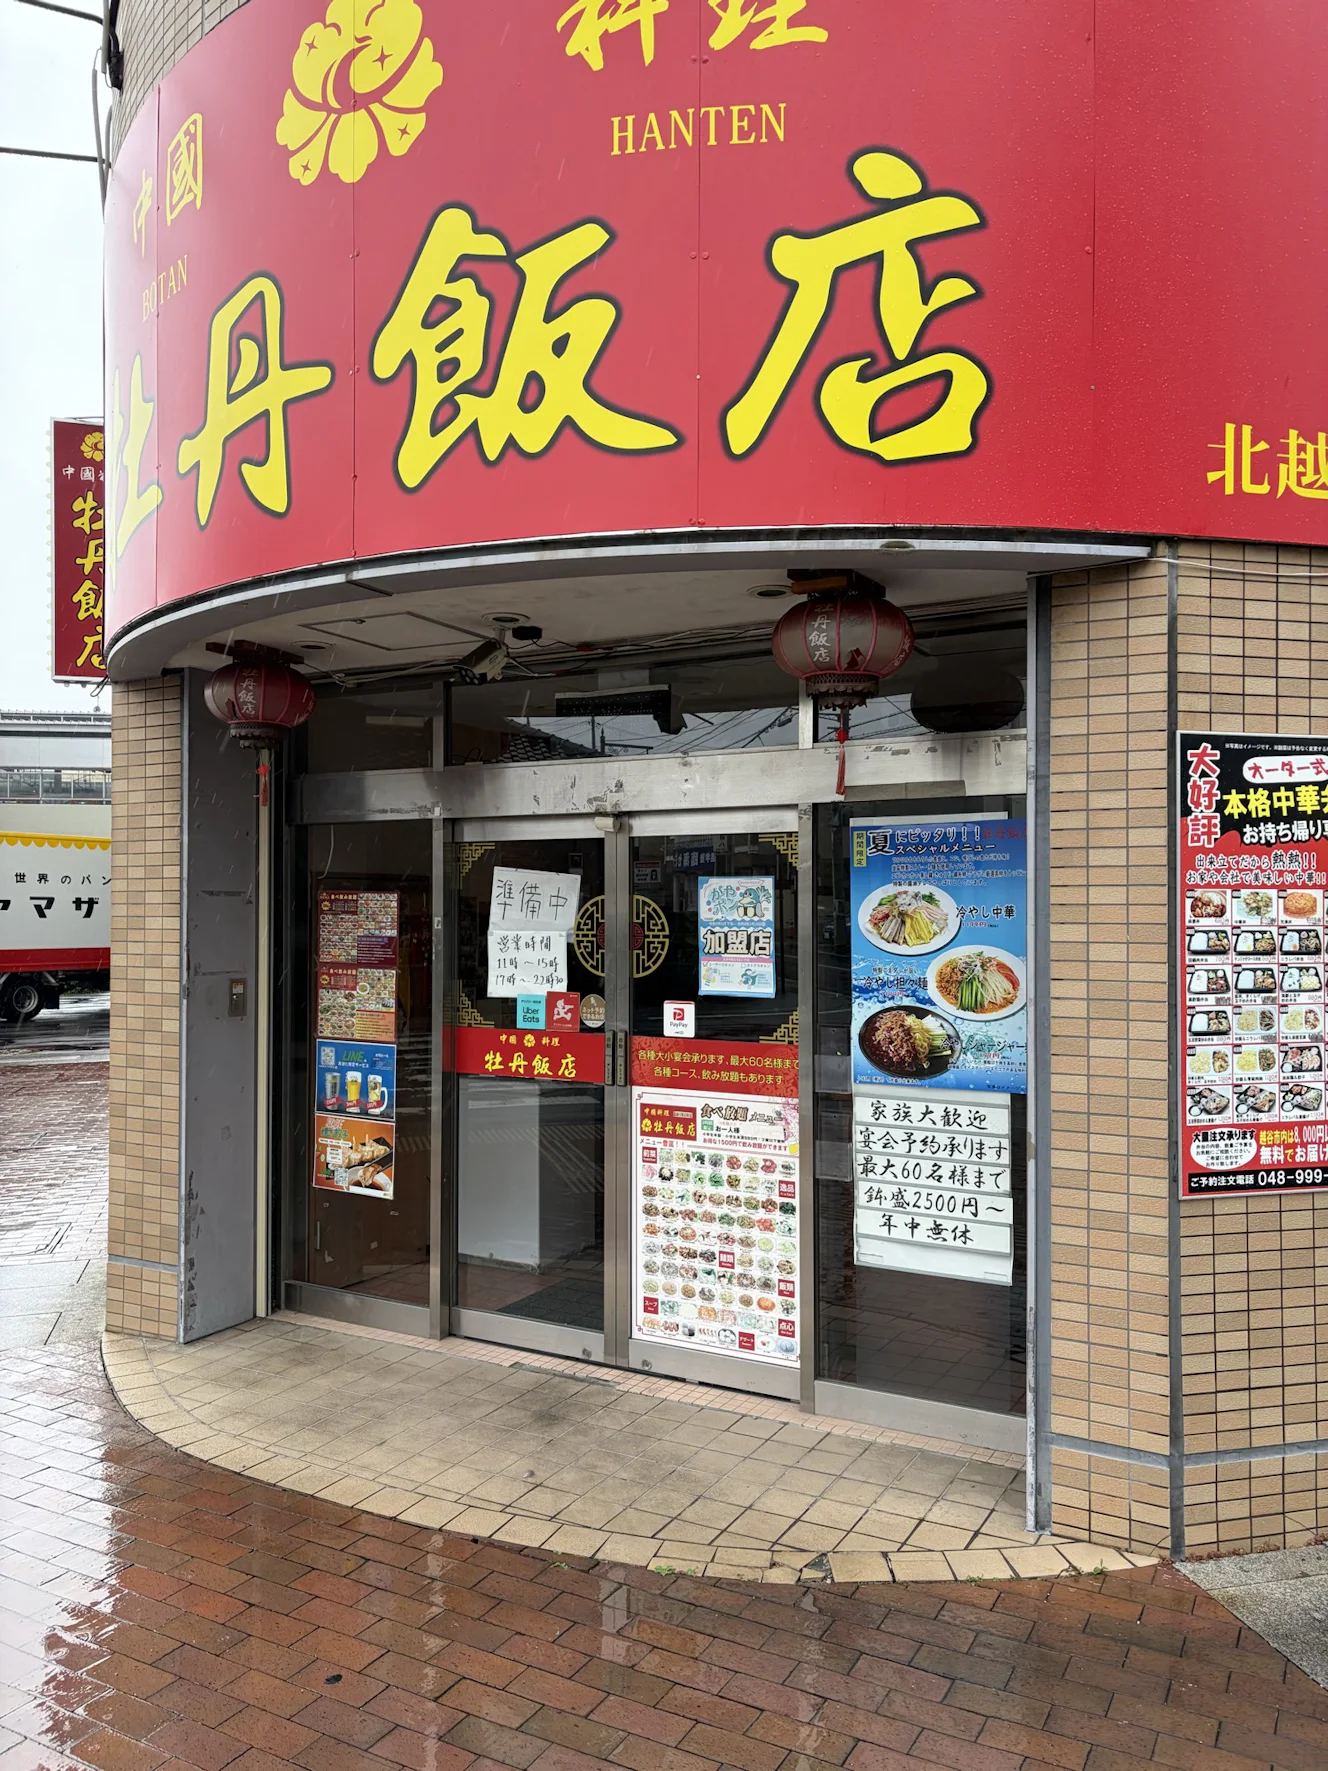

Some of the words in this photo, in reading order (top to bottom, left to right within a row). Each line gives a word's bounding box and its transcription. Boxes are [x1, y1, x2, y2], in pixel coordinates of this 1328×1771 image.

[142, 254, 189, 323] BOTAN
[610, 102, 787, 157] HANTEN
[1206, 421, 1328, 500] 北越
[1187, 743, 1220, 847] 大好評
[1222, 784, 1328, 820] 本格中華
[867, 829, 894, 857] 夏
[895, 844, 996, 856] スペシャルメニュー
[496, 879, 568, 921] 準備中
[957, 904, 1016, 920] 冷やし中華
[497, 933, 552, 954] 営業時間
[703, 929, 772, 956] 加盟店
[522, 1006, 540, 1015] Uber
[522, 1015, 540, 1023] Eats
[669, 1021, 689, 1029] PayPay
[341, 1050, 365, 1063] LINE
[484, 1050, 577, 1079] 牡丹飯店
[654, 1066, 784, 1086] 各種コース、飲み放題もあります
[701, 1103, 749, 1122] 食べ放題
[749, 1111, 784, 1126] メニュー
[871, 1100, 988, 1130] 家族大歓迎
[654, 1117, 696, 1137] 牡丹飯店
[716, 1125, 740, 1134] お一人様
[1193, 1131, 1256, 1143] 大量注文承ります
[856, 1127, 1008, 1161] 宴会予約承ります
[857, 1155, 1007, 1189] 最大60名様まで
[1190, 1174, 1255, 1188] ご予約注文電話
[878, 1212, 974, 1246] 年中無休
